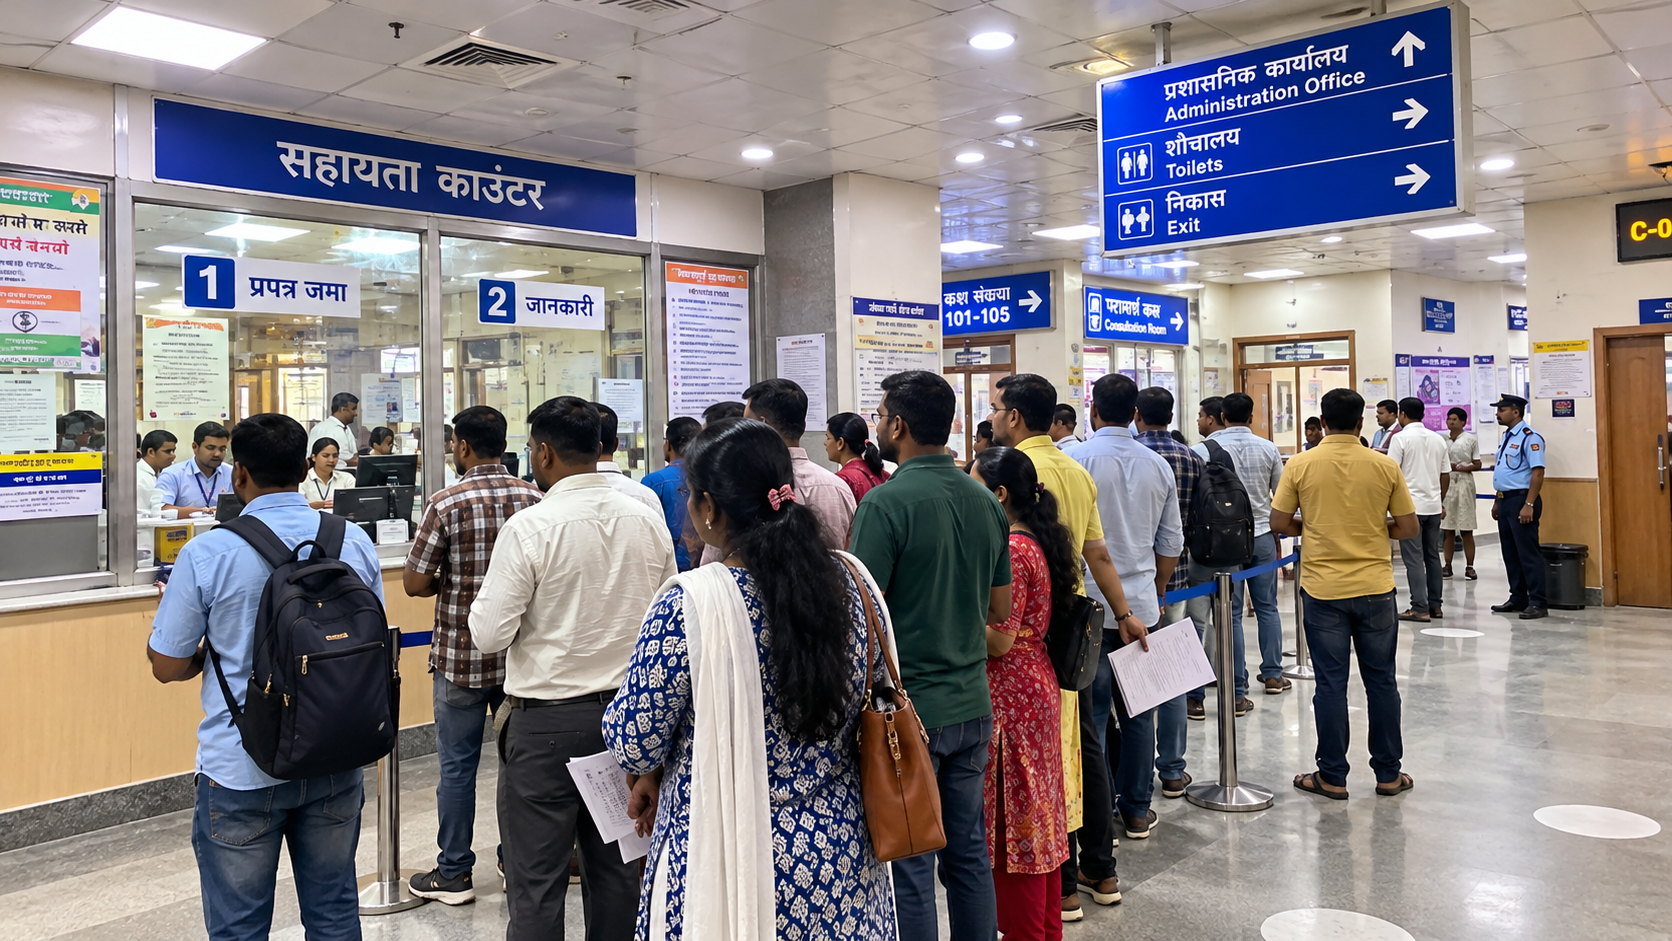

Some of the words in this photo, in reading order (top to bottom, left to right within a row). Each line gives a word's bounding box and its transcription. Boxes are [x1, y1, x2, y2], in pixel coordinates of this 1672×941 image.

[1164, 65, 1257, 101] प्रशासनिक
[1264, 45, 1349, 78] कार्यालय
[1164, 85, 1299, 123] Administration
[1304, 71, 1366, 94] Office
[1165, 127, 1242, 157] शौचालय
[276, 140, 422, 194] सहायता
[435, 163, 546, 211] काउंटर
[1166, 158, 1224, 179] Toilets
[1165, 189, 1227, 214] निकास
[1168, 217, 1201, 236] Exit
[199, 264, 218, 300] 1
[249, 277, 299, 299] प्रपत्र
[304, 281, 348, 302] जमा
[488, 286, 508, 317] 2
[525, 293, 595, 317] जानकारी
[945, 306, 1011, 327] 101-105
